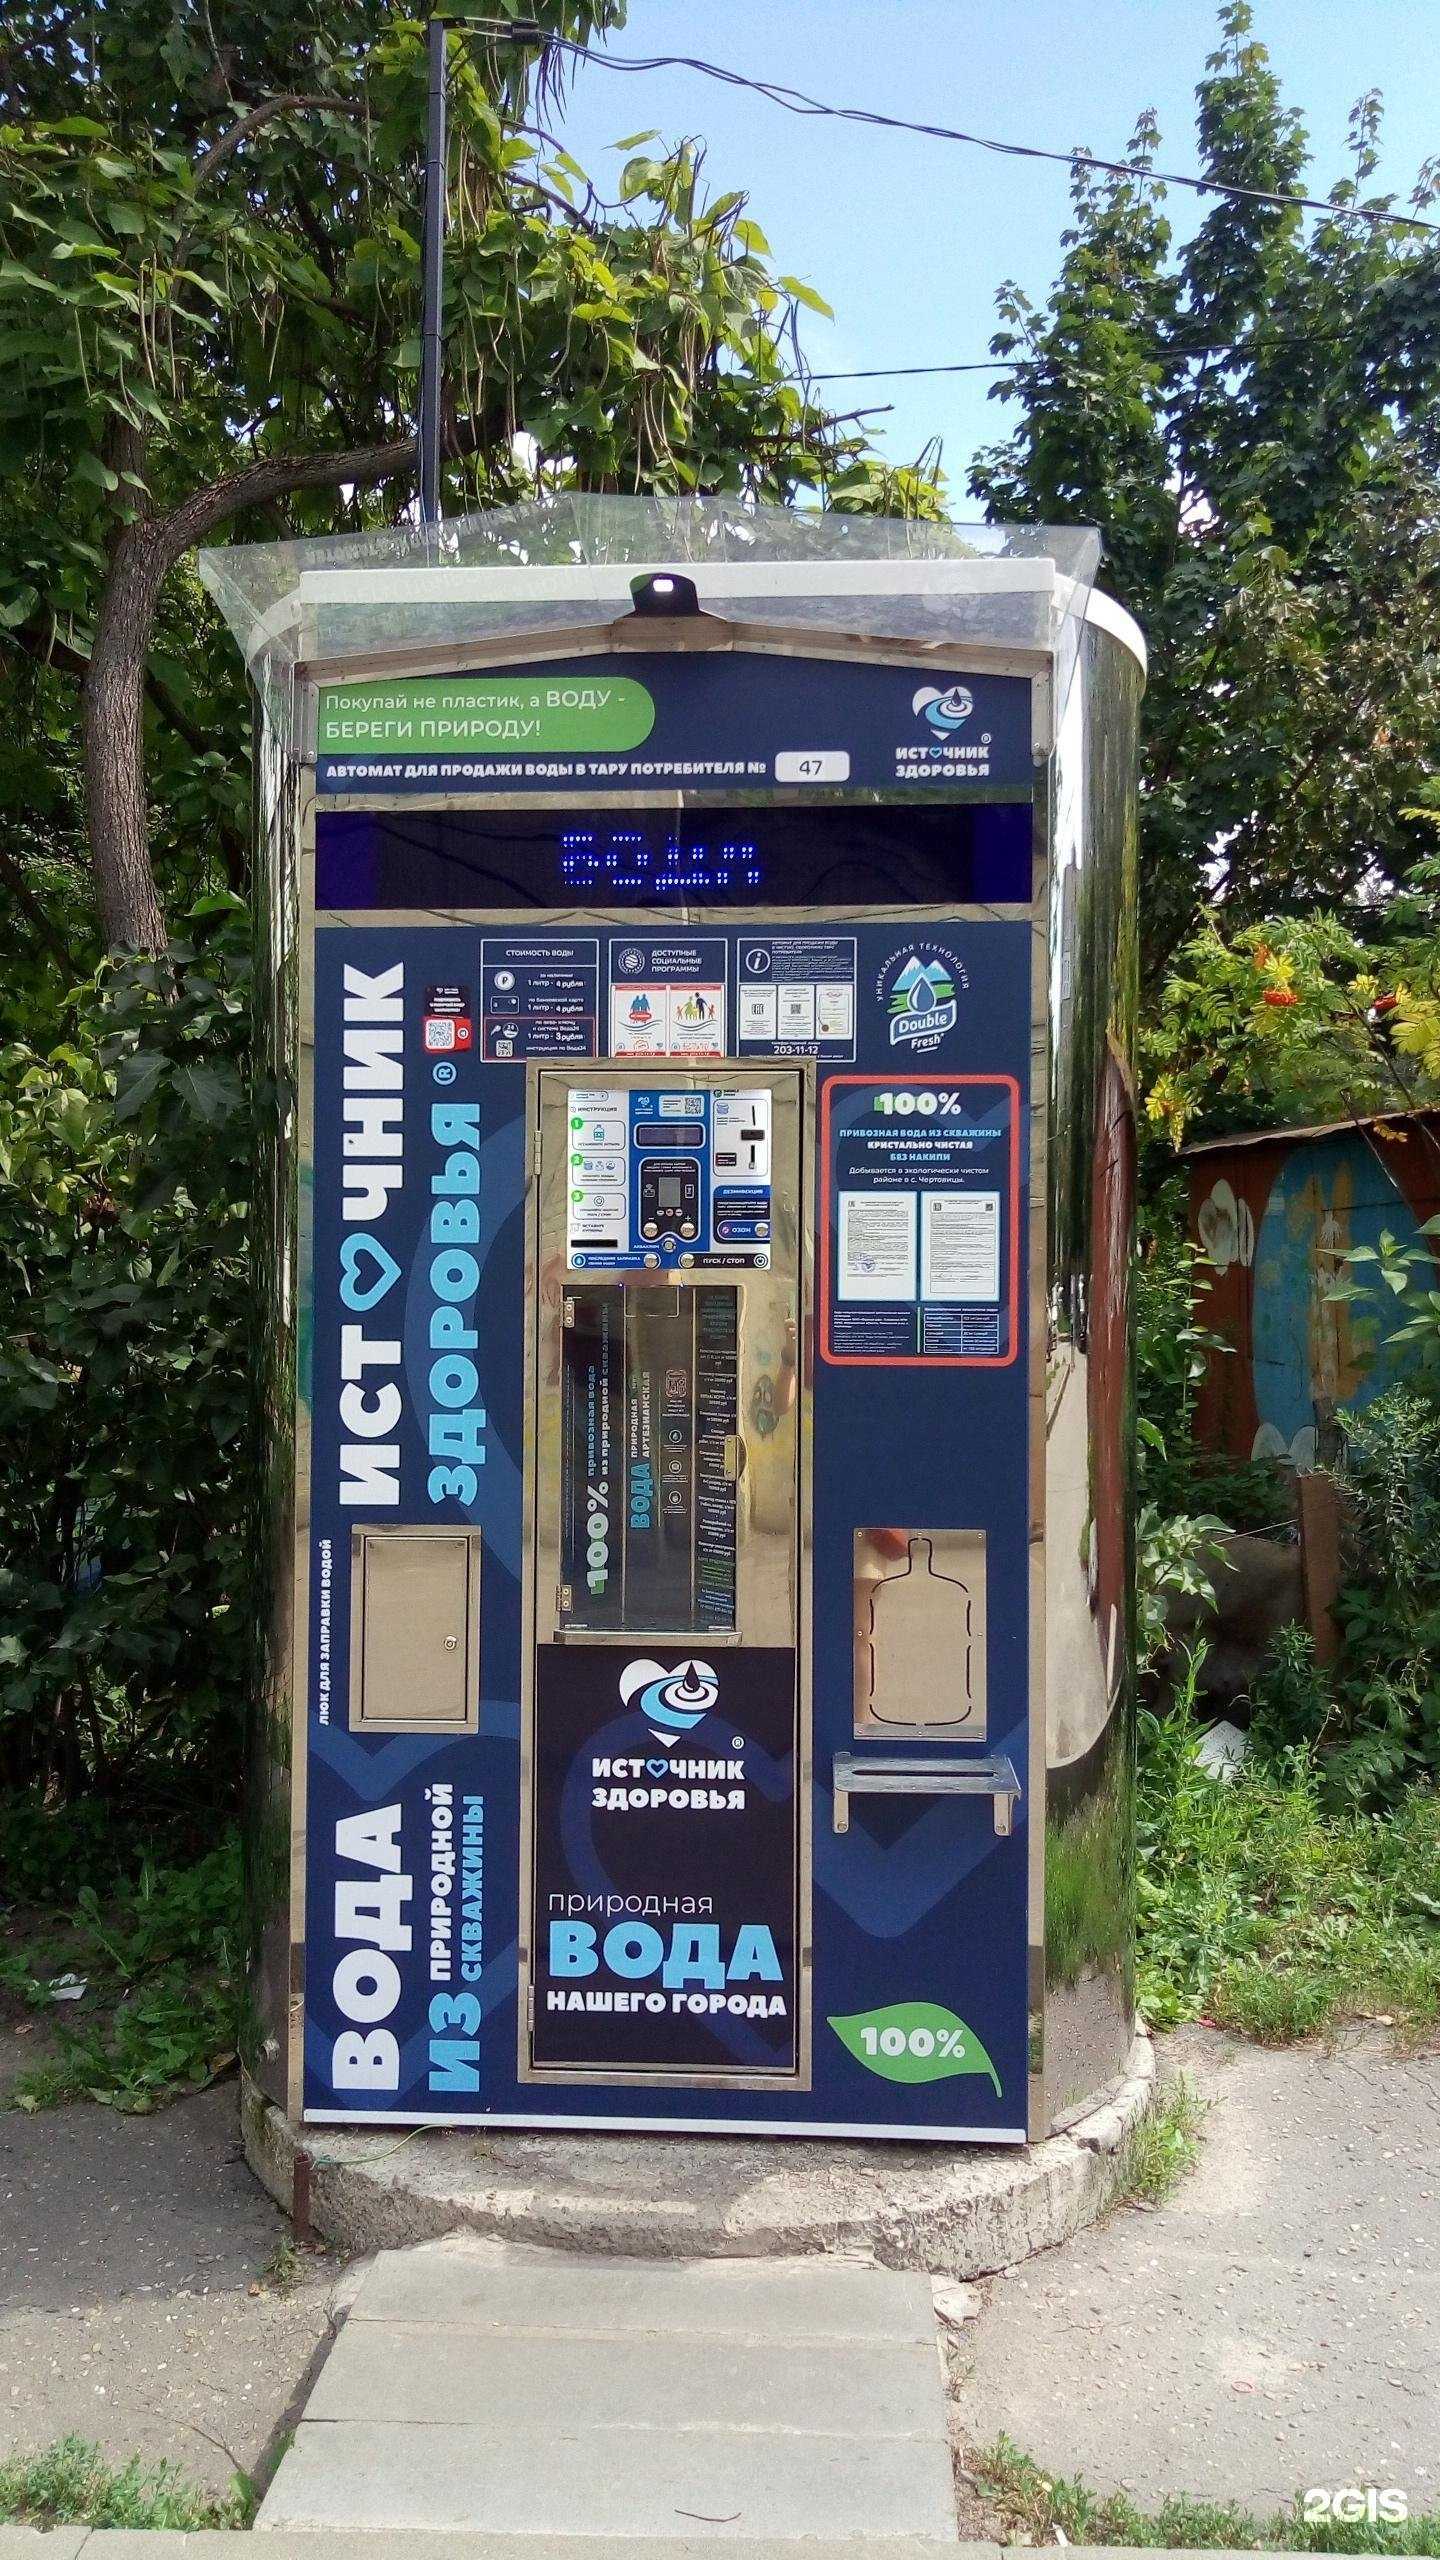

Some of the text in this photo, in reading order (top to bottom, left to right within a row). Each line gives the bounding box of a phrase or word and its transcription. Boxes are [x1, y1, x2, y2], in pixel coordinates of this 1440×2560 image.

[326, 694, 408, 711] Покупай
[413, 697, 436, 710] не
[442, 695, 524, 712] пластик,
[530, 697, 540, 708] а
[547, 689, 611, 709] ВОДУ
[326, 720, 541, 739] БЕРЕГИ ПРИРОДУ!
[326, 760, 823, 778] АВТОМАТ ДЛЯ ПРОДАЖИ ВОДЫ В ТАРУ ПОТРЕБИТЕЛЯ № 47
[895, 763, 990, 779] ЗДОРОВЬЯ
[505, 949, 574, 958] СТОИМОСТЬ ВОДЫ
[651, 949, 698, 958] ДОСТУПНЫЕ
[651, 957, 703, 966] СОЦИАЛЬНЫЕ
[651, 966, 701, 974] ПРОГРАММЫ
[532, 1004, 550, 1012] литр
[561, 1004, 584, 1014] рубля
[898, 1012, 948, 1034] Double
[532, 1033, 550, 1041] литр
[555, 1032, 561, 1041] 3
[561, 1033, 584, 1042] рубля
[910, 1034, 941, 1049] Fresh
[773, 1045, 819, 1055] 203-11-12
[879, 1092, 962, 1116] 100%
[839, 1129, 1002, 1138] ПРИВОЗНАЯ ВОДА ИЗ СКВАЖИНЫ
[867, 1141, 973, 1150] КРИСТАЛЬНО ЧИСТАЯ
[890, 1153, 951, 1161] БЕЗ НАКИПИ
[427, 1102, 487, 1507] ЗДОРОВЬЯ
[599, 1378, 611, 1457] природной
[642, 1371, 651, 1458] АРТЕЗИАНСКАЯ
[586, 1365, 609, 1588] 100% привозная вода
[601, 1459, 609, 1476] из
[630, 1462, 653, 1529] ВОДА
[318, 1539, 332, 1726] ЛЮК ДЛЯ ЗАПРАВКИ ВОДОЙ
[591, 1787, 746, 1811] ЗДОРОВЬЯ
[460, 1795, 484, 1982] СКВАЖИНЫ
[548, 1893, 714, 1917] природная
[331, 1803, 413, 2091] ВОДА
[424, 1783, 482, 2092] ИЗ ПРИРОДНОЙ
[549, 1920, 784, 1990] ВОДА
[547, 1990, 788, 2019] НАШЕГО ГОРОДА
[860, 2026, 966, 2060] 100%
